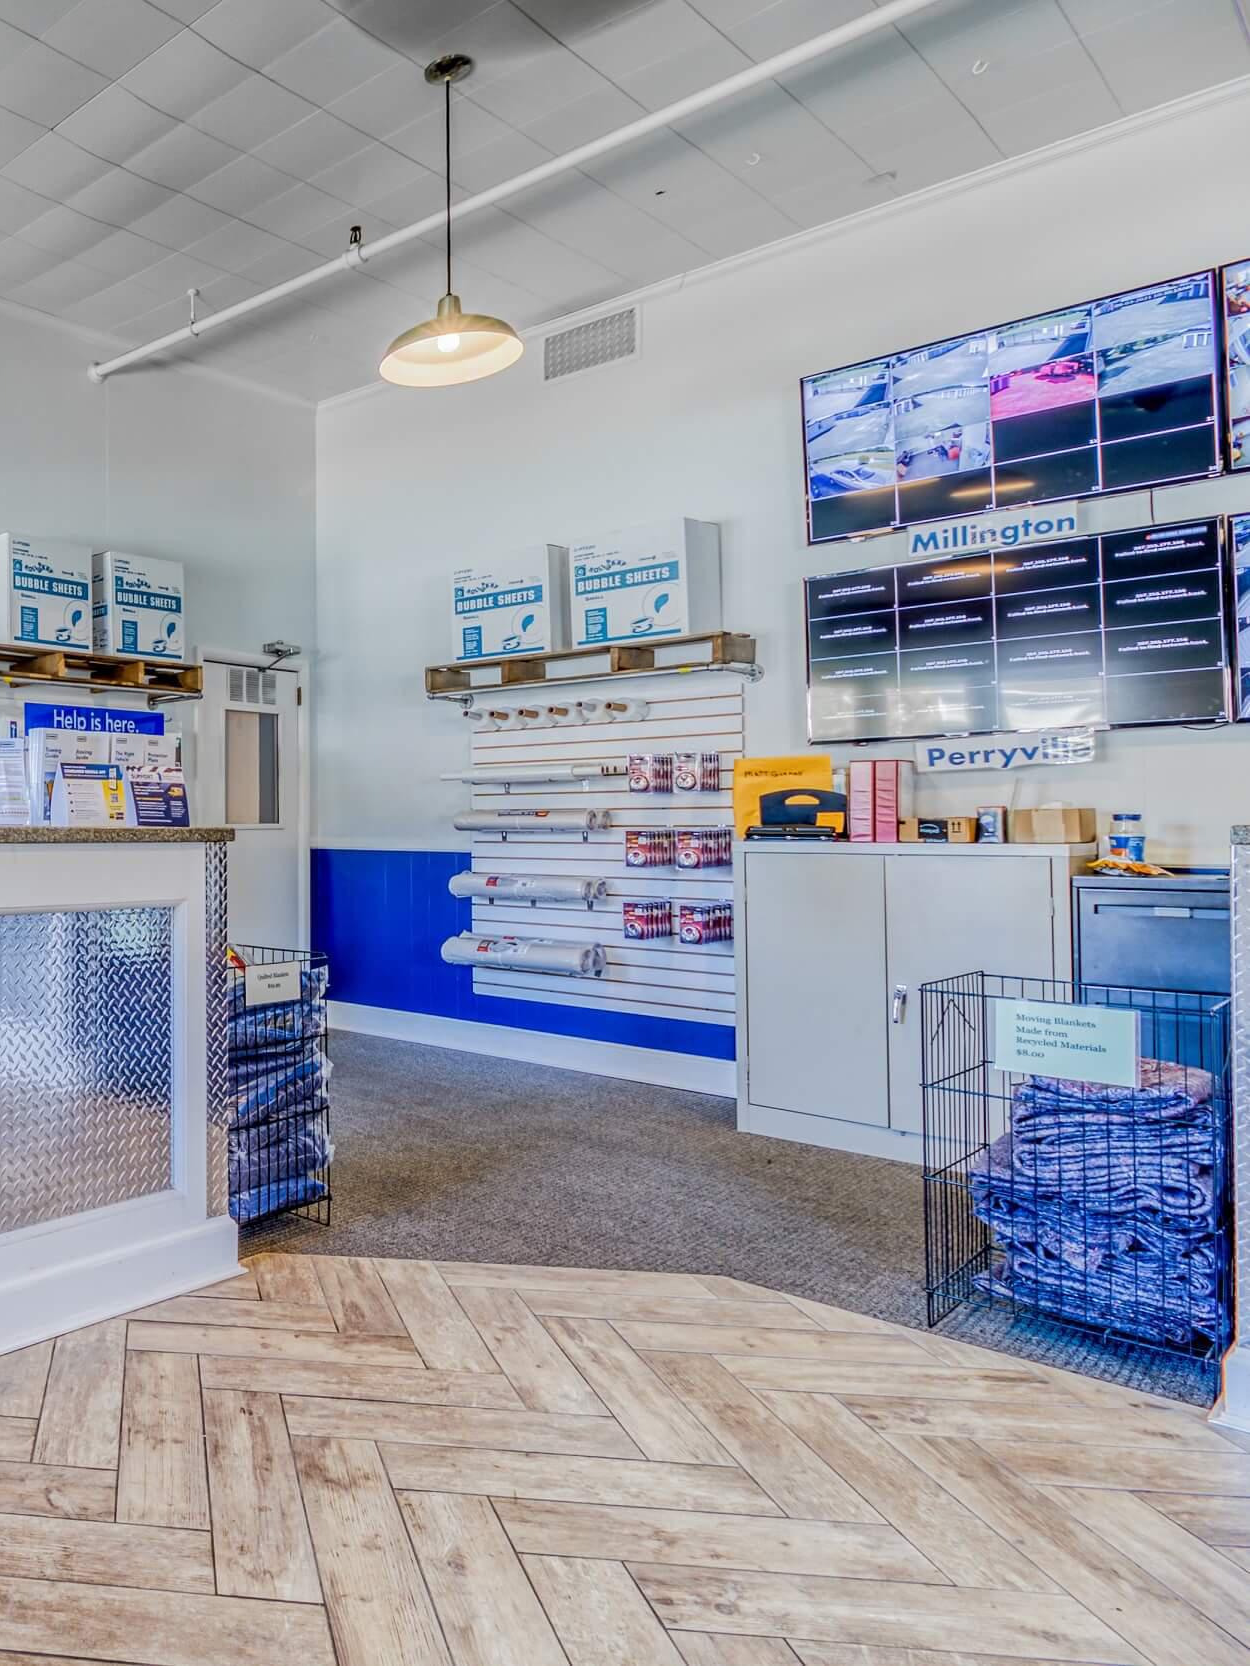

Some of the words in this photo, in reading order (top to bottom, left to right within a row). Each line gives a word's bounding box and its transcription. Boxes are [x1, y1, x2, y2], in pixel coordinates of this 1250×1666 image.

[911, 516, 1075, 553] Millington
[15, 575, 49, 592] BUBBLE
[52, 582, 83, 596] SHEETS
[577, 574, 621, 593] BUBBLE
[626, 566, 670, 585] SHEETS
[117, 591, 147, 606] BUBBLE
[150, 597, 176, 610] SHEETS
[456, 596, 494, 613] BUBBLE
[497, 589, 535, 605] SHEETS
[53, 709, 87, 730] Help
[91, 712, 102, 730] is
[105, 712, 140, 733] here.
[1016, 1013, 1051, 1025] Moving
[1054, 1017, 1097, 1028] Blankets
[1016, 1026, 1042, 1035] Made
[1044, 1029, 1068, 1038] from
[1016, 1036, 1058, 1047] Recycled
[1060, 1041, 1107, 1053] Materials
[1016, 1048, 1045, 1058] $8.00
